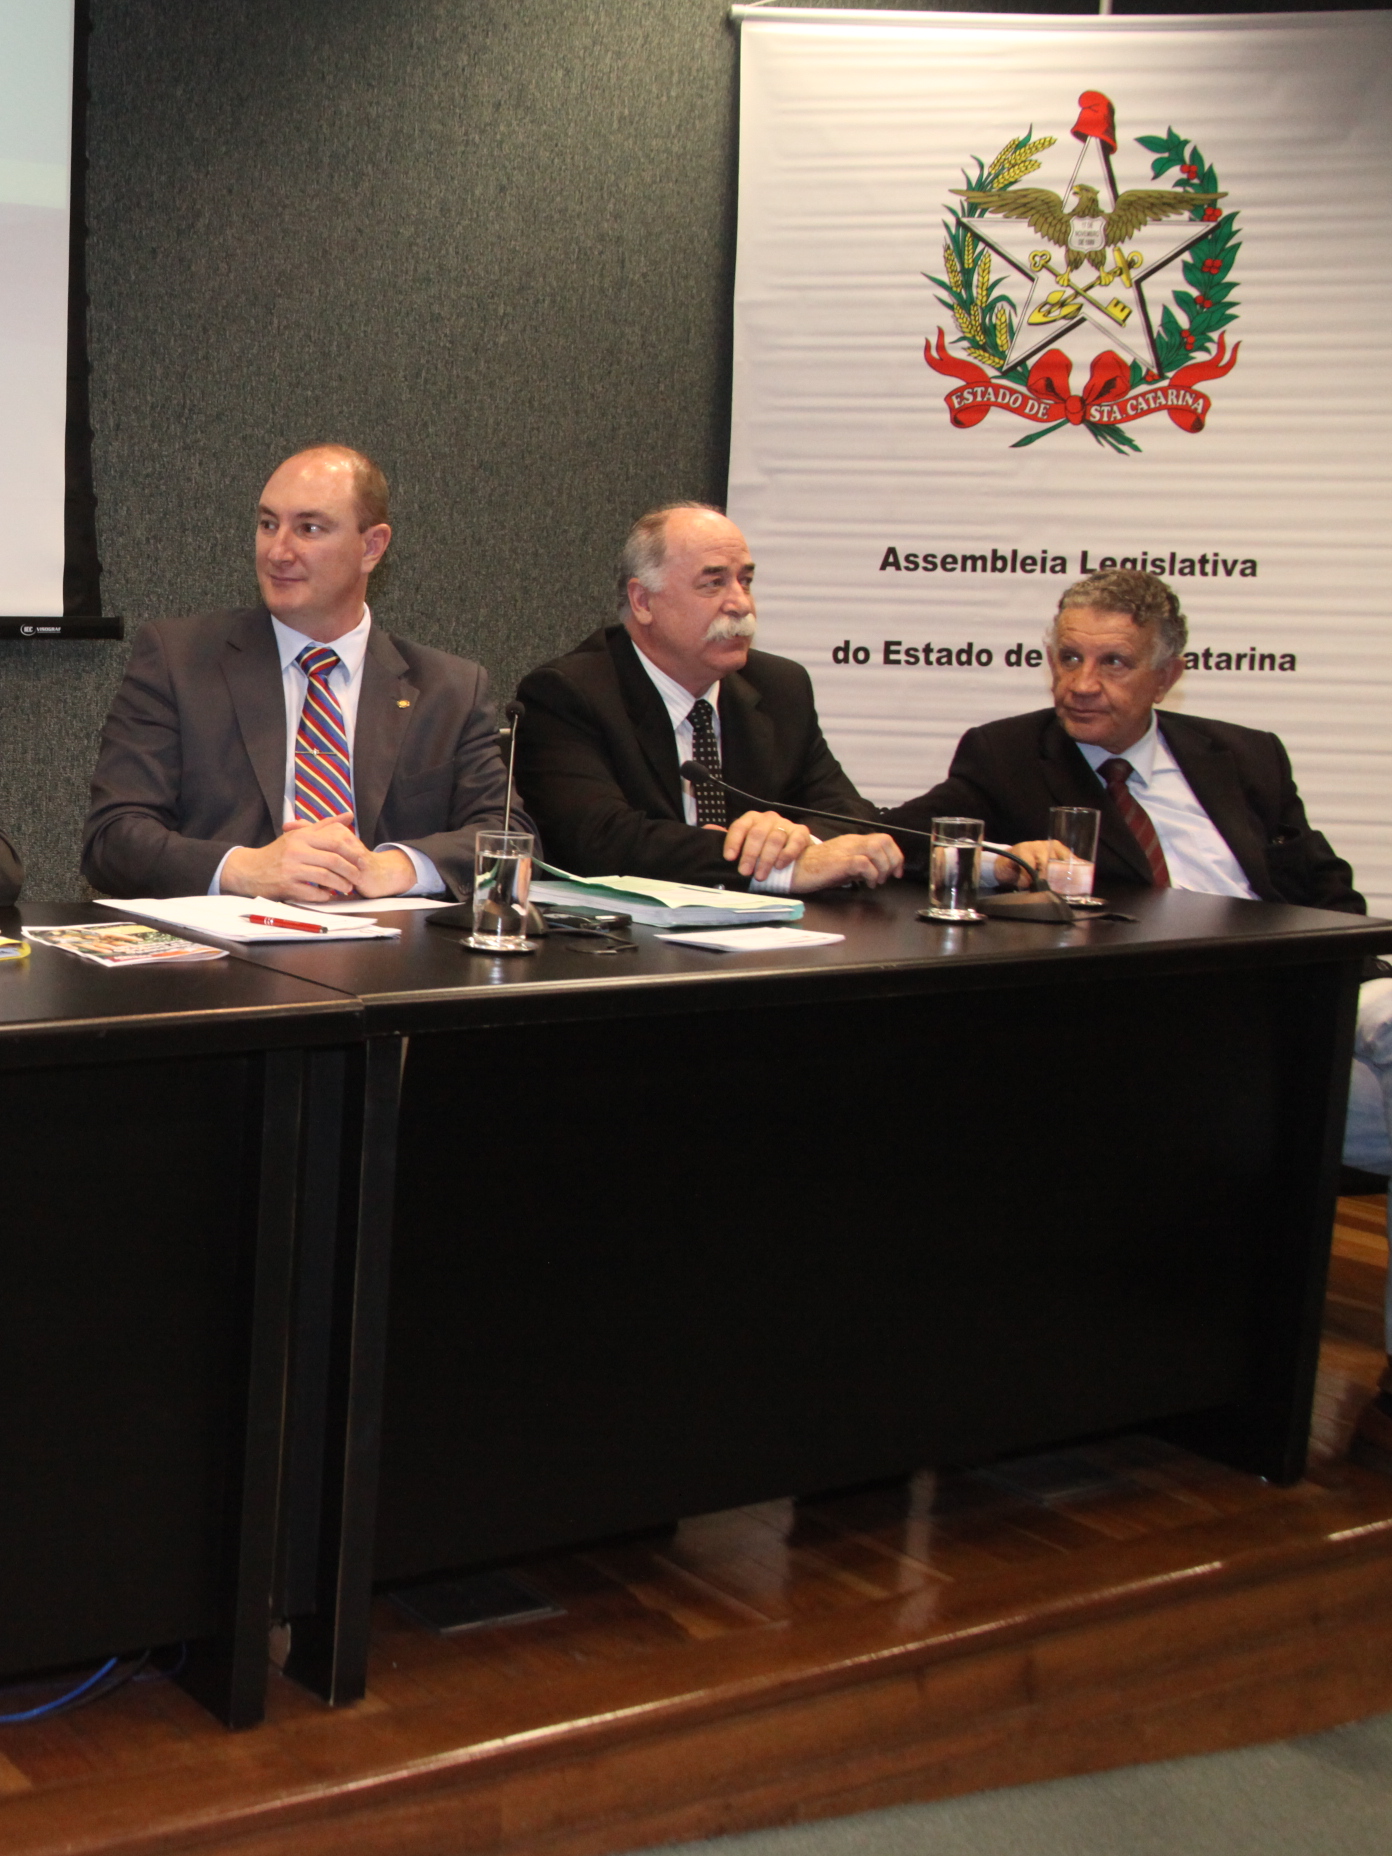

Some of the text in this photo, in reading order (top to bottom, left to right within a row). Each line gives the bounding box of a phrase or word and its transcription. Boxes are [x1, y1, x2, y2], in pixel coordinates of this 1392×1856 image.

[952, 386, 1023, 409] ESTADO
[1024, 399, 1050, 419] DE
[1127, 389, 1204, 415] CATARINA
[879, 546, 1068, 575] Assembleia
[832, 639, 1297, 672] do Estado de atarina
